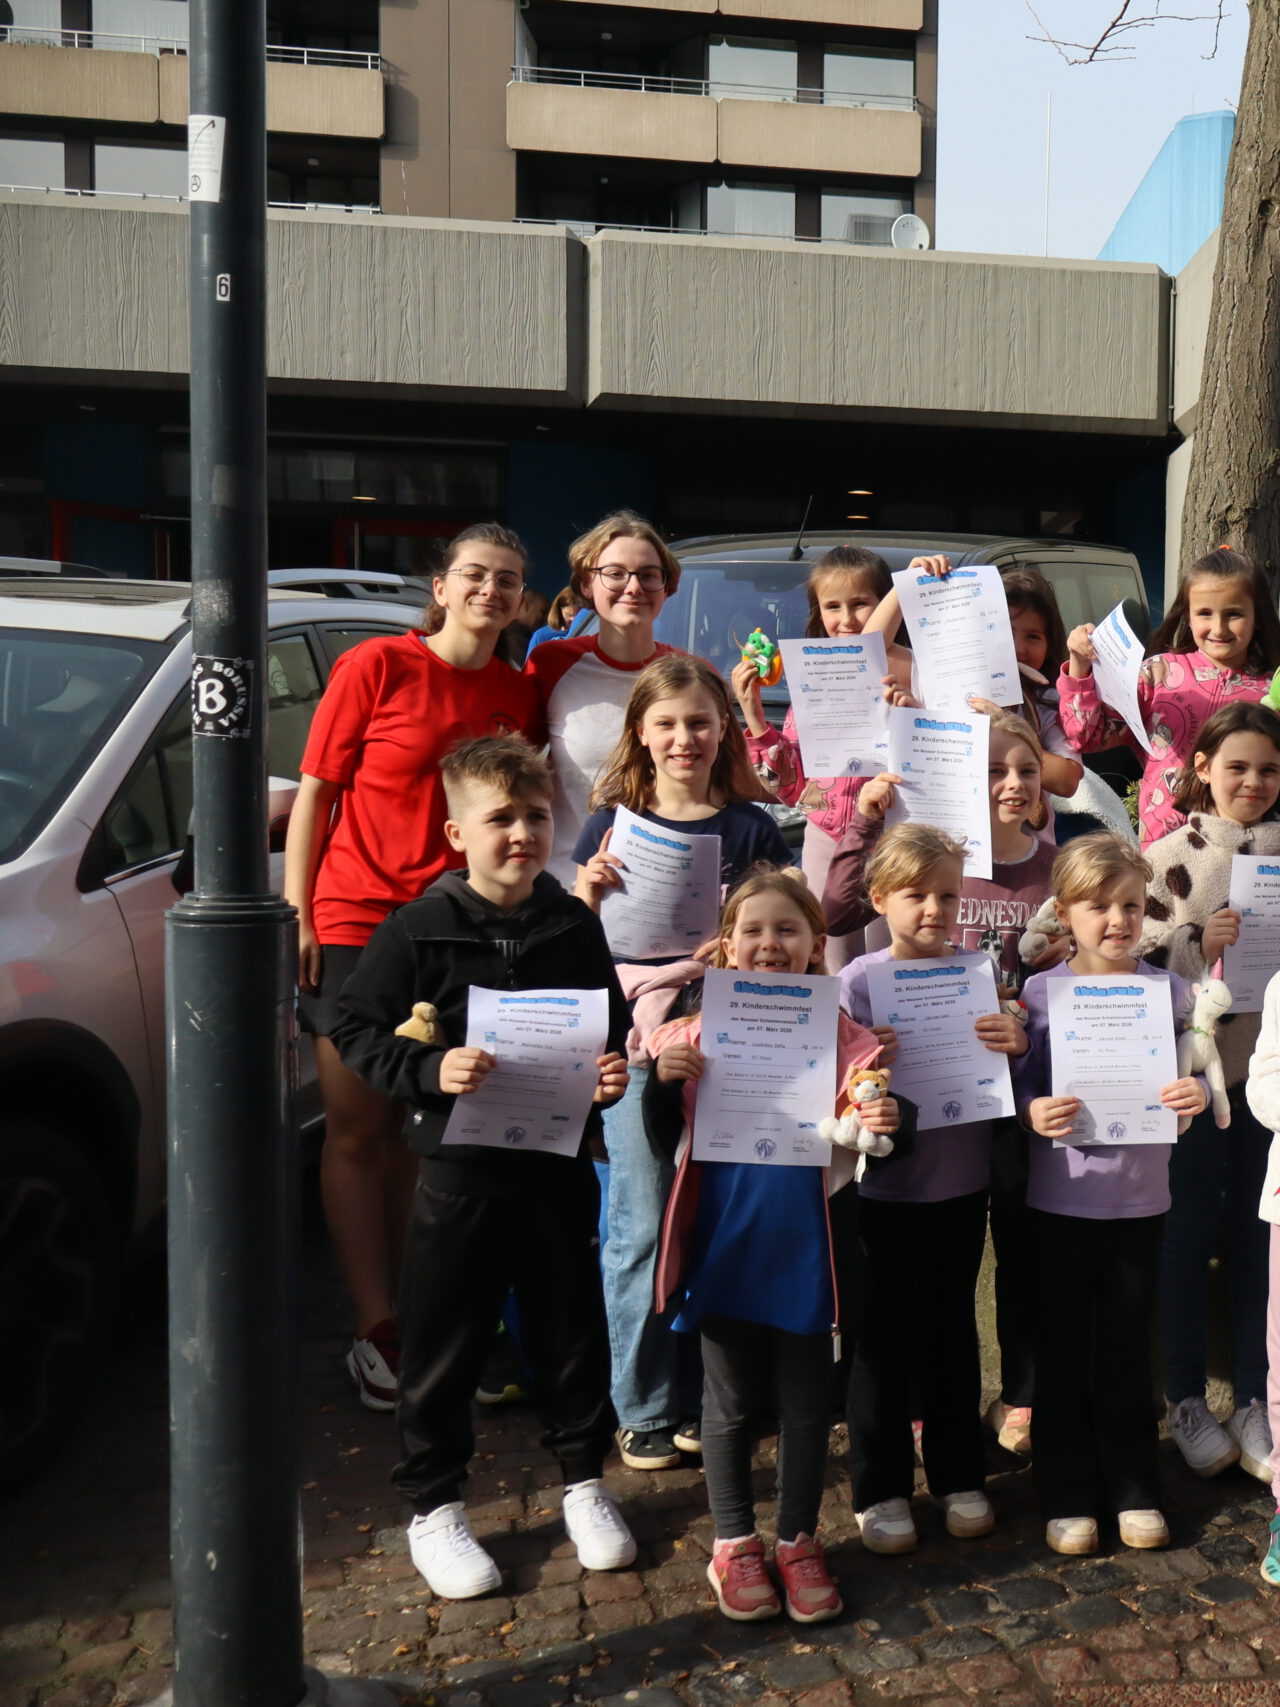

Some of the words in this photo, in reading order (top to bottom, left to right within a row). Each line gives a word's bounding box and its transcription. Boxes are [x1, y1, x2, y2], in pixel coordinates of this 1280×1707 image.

[219, 276, 229, 297] 6
[198, 678, 227, 714] B
[742, 1002, 812, 1013] Kinderschwimmfest
